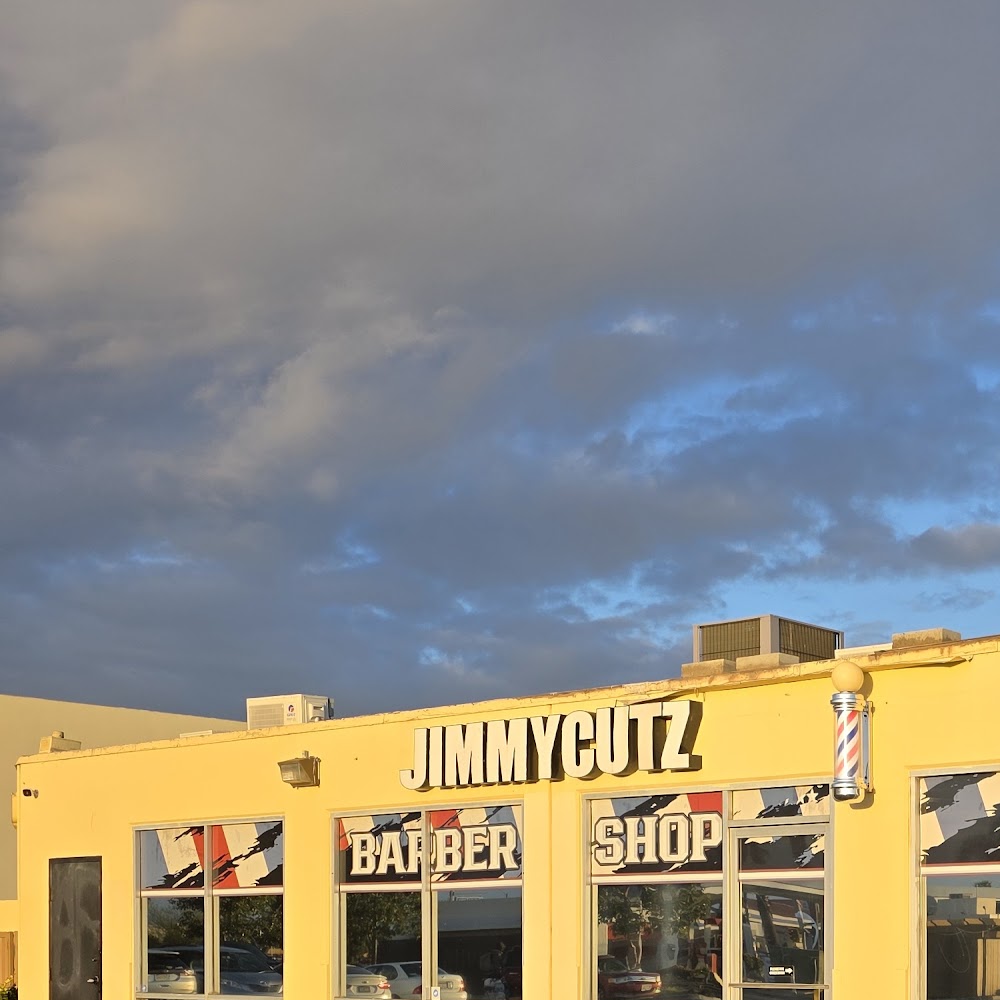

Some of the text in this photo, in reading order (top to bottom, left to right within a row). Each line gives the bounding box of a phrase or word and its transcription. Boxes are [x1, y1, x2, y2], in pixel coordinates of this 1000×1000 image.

[399, 700, 702, 791] JIMMYCUTZ
[350, 811, 723, 876] BARBER SHOP
